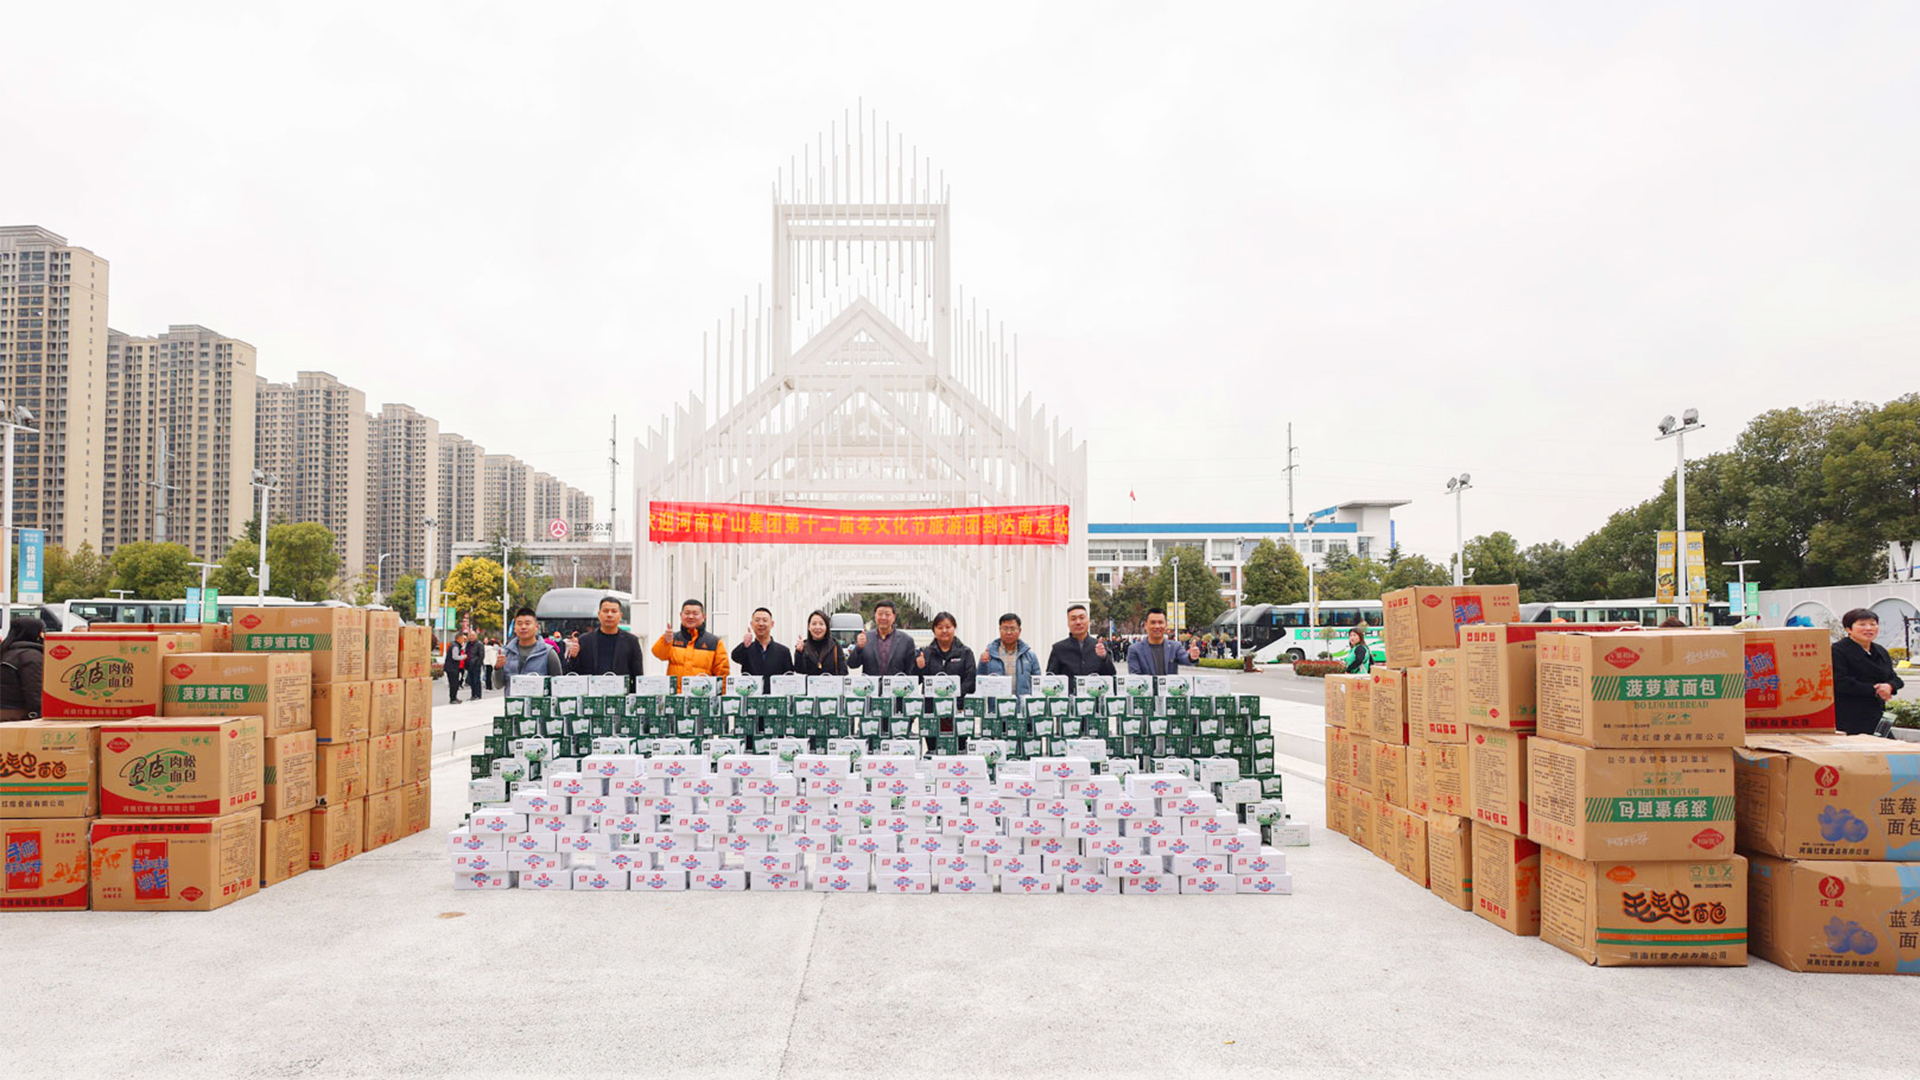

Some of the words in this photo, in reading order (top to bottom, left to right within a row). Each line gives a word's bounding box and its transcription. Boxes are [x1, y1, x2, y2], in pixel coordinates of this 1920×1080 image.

[251, 635, 311, 649] 菠萝蜜面包
[182, 686, 245, 701] 菠萝蜜面包
[1625, 678, 1717, 698] 菠萝蜜面包
[1680, 700, 1709, 709] BREAD
[170, 755, 196, 768] 肉松
[170, 771, 196, 783] 面包
[1618, 800, 1708, 819] 菠萝蜜面包
[1879, 798, 1917, 815] 蓝莓
[1622, 890, 1727, 925] 毛毛虫面包
